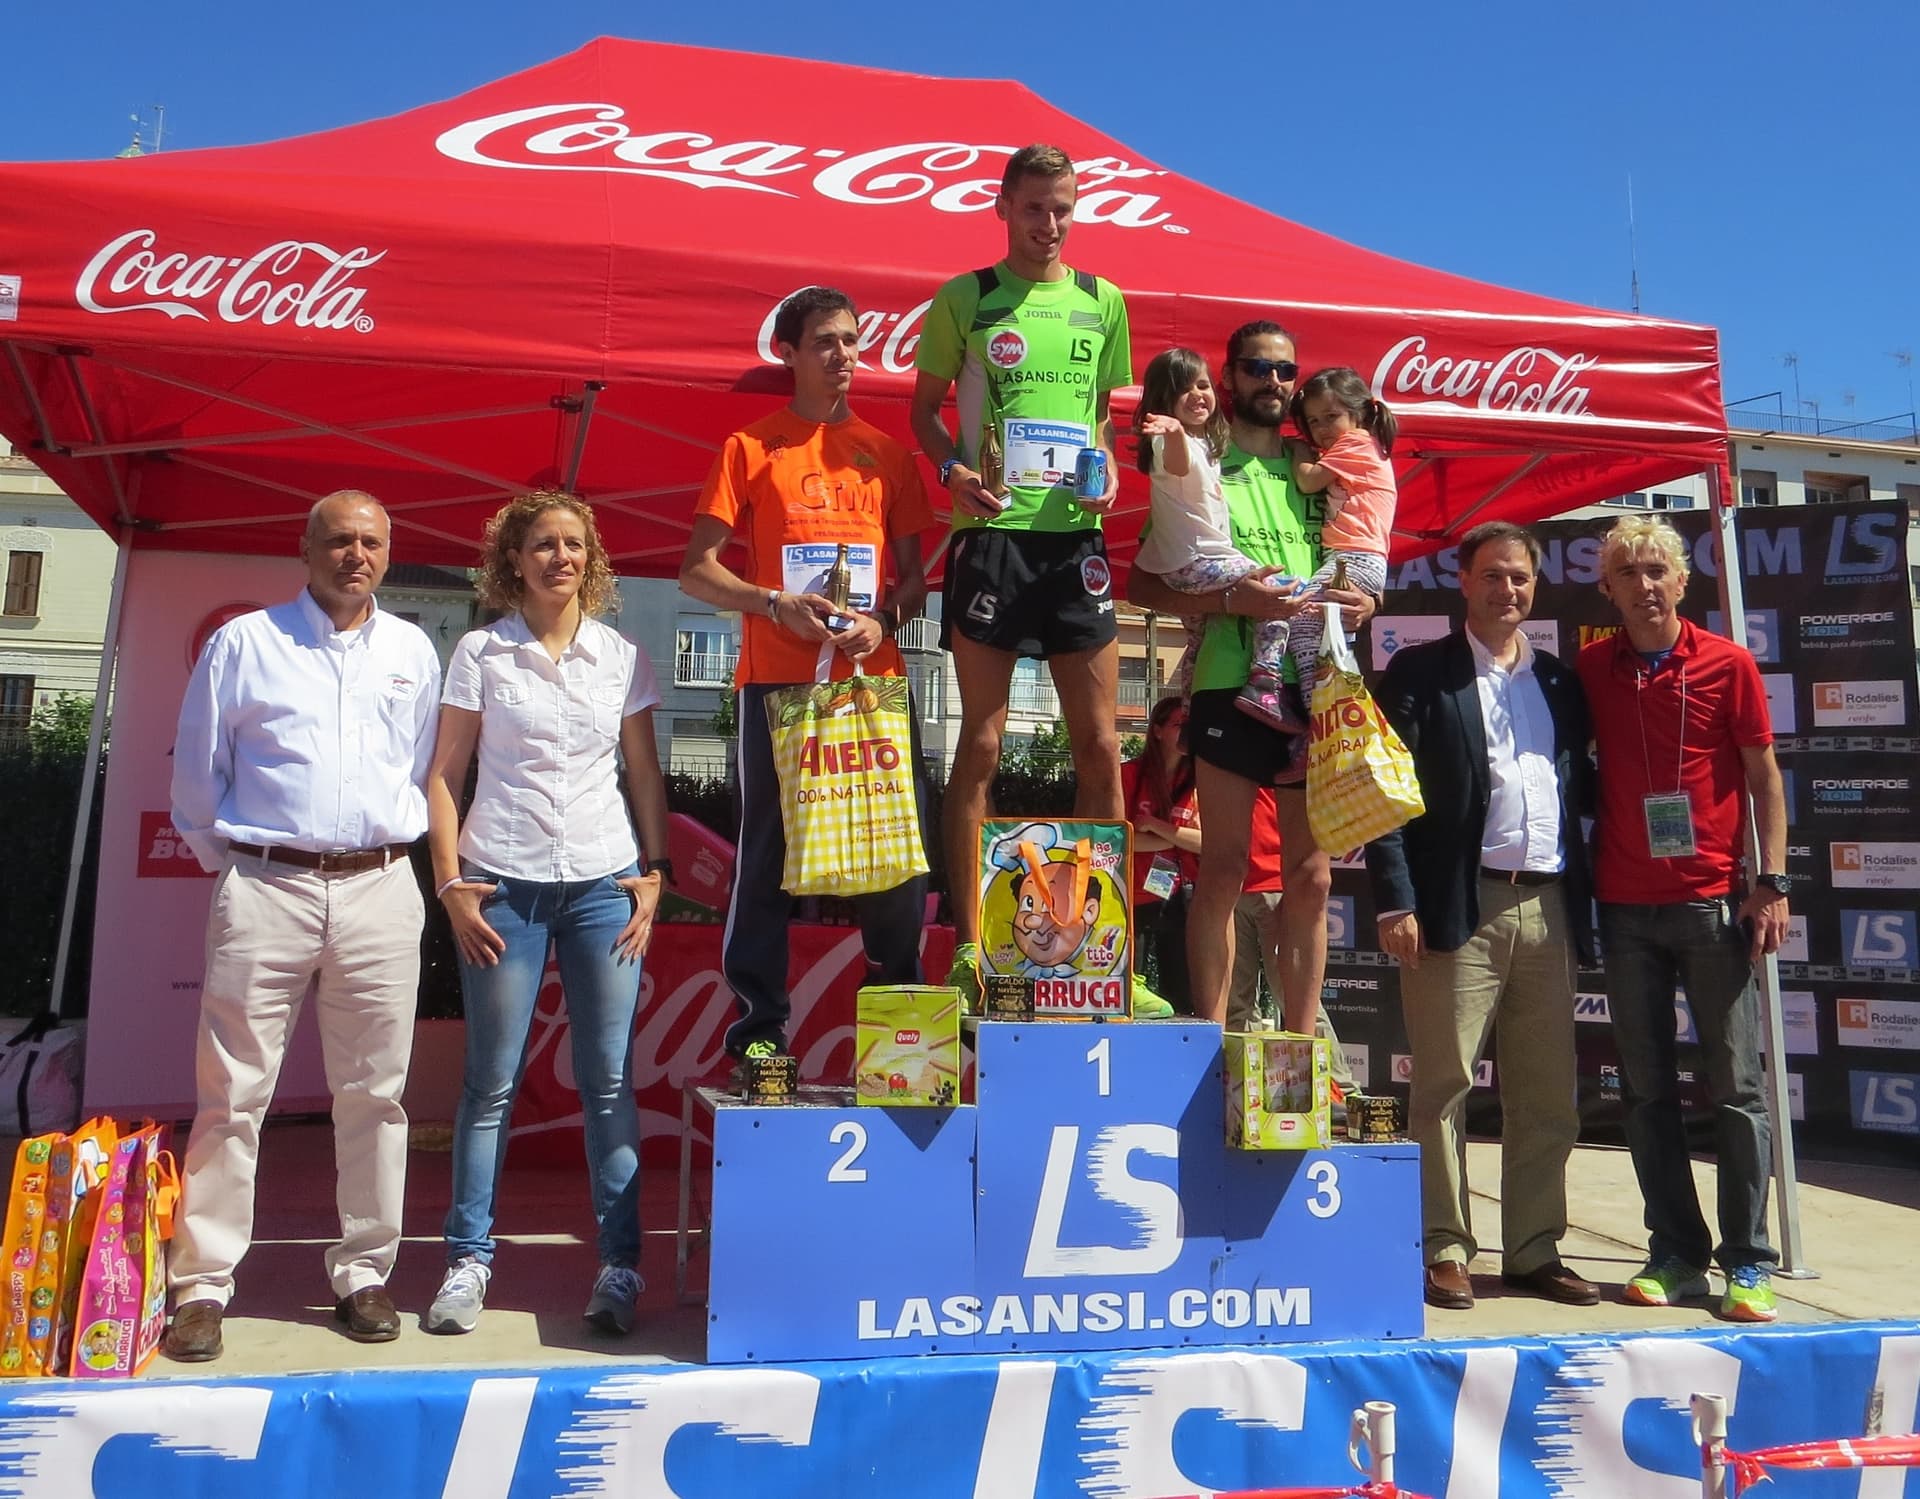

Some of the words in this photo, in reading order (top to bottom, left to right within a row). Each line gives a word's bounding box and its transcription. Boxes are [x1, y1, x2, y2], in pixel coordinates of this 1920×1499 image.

[75, 229, 387, 331] Coca-Cola
[991, 342, 1024, 357] SYM
[1069, 338, 1092, 363] LS
[995, 371, 1090, 385] LASANSI.COM
[1370, 335, 1600, 417] Coca-Cola
[1009, 424, 1025, 438] LS
[1028, 428, 1087, 441] LASANSI.COM
[1042, 447, 1055, 468] 1
[1237, 526, 1322, 545] LASANSI.CO
[1824, 512, 1898, 576] LS
[788, 548, 804, 562] LS
[1085, 570, 1107, 584] SYM
[966, 592, 998, 621] LS
[1800, 611, 1895, 625] POWERADE
[1845, 693, 1899, 703] Rodalies
[830, 779, 905, 801] NATURAL
[1812, 779, 1910, 790] POWERADE
[1095, 843, 1111, 854] Be
[1864, 854, 1917, 865] Rodalies
[1852, 914, 1906, 960] LS
[1086, 947, 1114, 961] tito
[1035, 980, 1121, 1008] RRUCA
[760, 1059, 787, 1067] CALDO
[1086, 1038, 1110, 1096] 1
[1862, 1076, 1917, 1125] LS
[827, 1121, 868, 1183] 2
[1023, 1123, 1185, 1278] LS
[1306, 1160, 1342, 1219] 3
[857, 1287, 1312, 1342] LASANSI.COM
[117, 1319, 132, 1370] CHURRUCA
